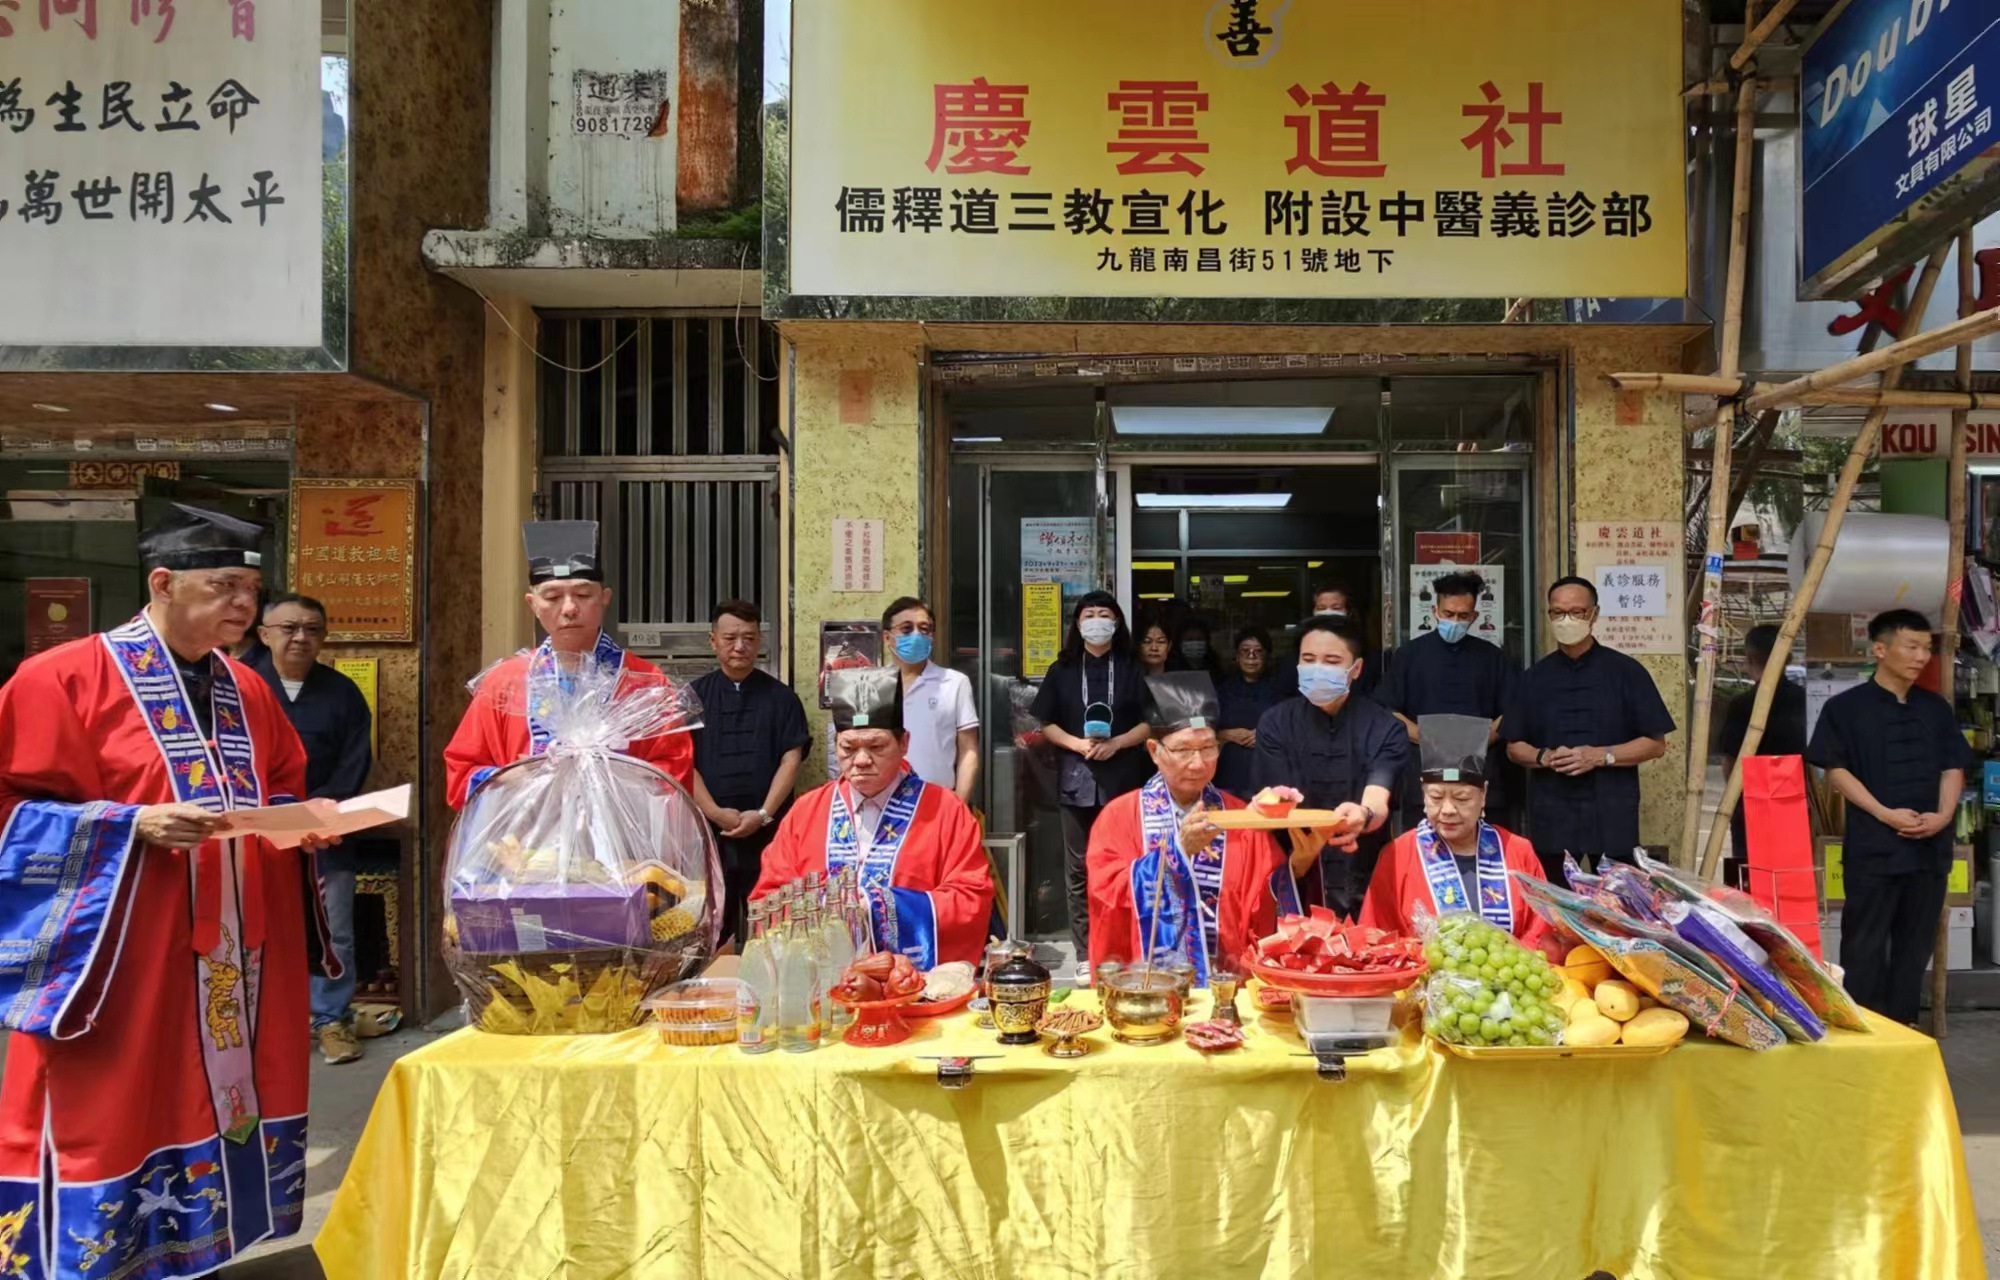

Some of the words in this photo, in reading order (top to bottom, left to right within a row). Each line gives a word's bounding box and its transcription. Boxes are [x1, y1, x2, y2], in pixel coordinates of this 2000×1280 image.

[1217, 0, 1273, 57] 善
[575, 115, 654, 133] 9081728
[925, 77, 1565, 178] 慶雲道社
[1907, 64, 1978, 158] 球星
[1895, 105, 1992, 199] 文具有限公司
[0, 169, 285, 227] 萬世開太平
[834, 186, 1228, 237] 儒釋道三教宣化
[1264, 189, 1653, 239] 附設中醫義診部
[1096, 246, 1395, 274] 九龍南昌街51號地下
[1882, 423, 1937, 453] KOU
[1598, 526, 1662, 539] 慶雲道社
[1603, 572, 1661, 588] 義診服務
[1618, 594, 1646, 609] 暫停
